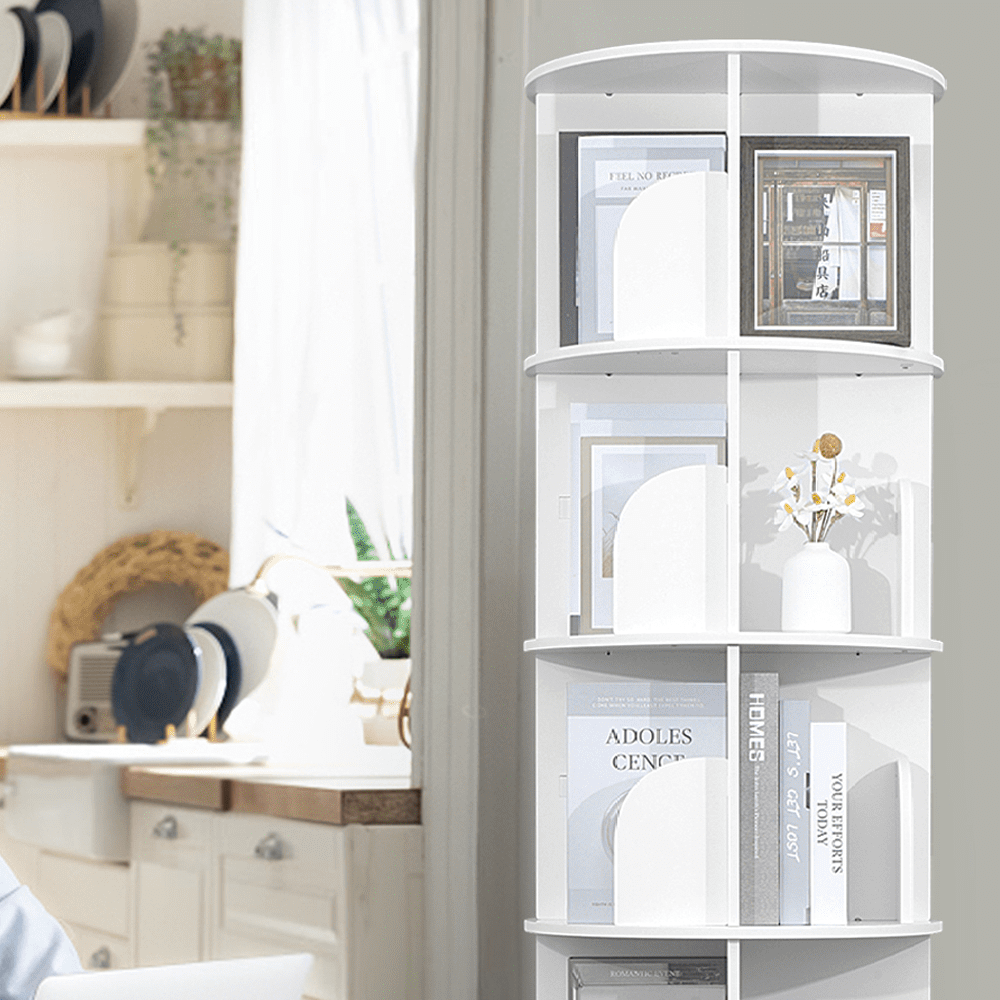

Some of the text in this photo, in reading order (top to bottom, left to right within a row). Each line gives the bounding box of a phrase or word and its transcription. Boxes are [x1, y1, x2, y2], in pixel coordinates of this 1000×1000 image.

[637, 172, 653, 181] NO
[605, 727, 692, 745] ADOLES
[749, 693, 765, 762] HOMES
[786, 788, 801, 818] GET
[817, 799, 828, 847] TODAY
[831, 773, 843, 874] YOUR EFFORTS
[786, 825, 801, 863] LOST
